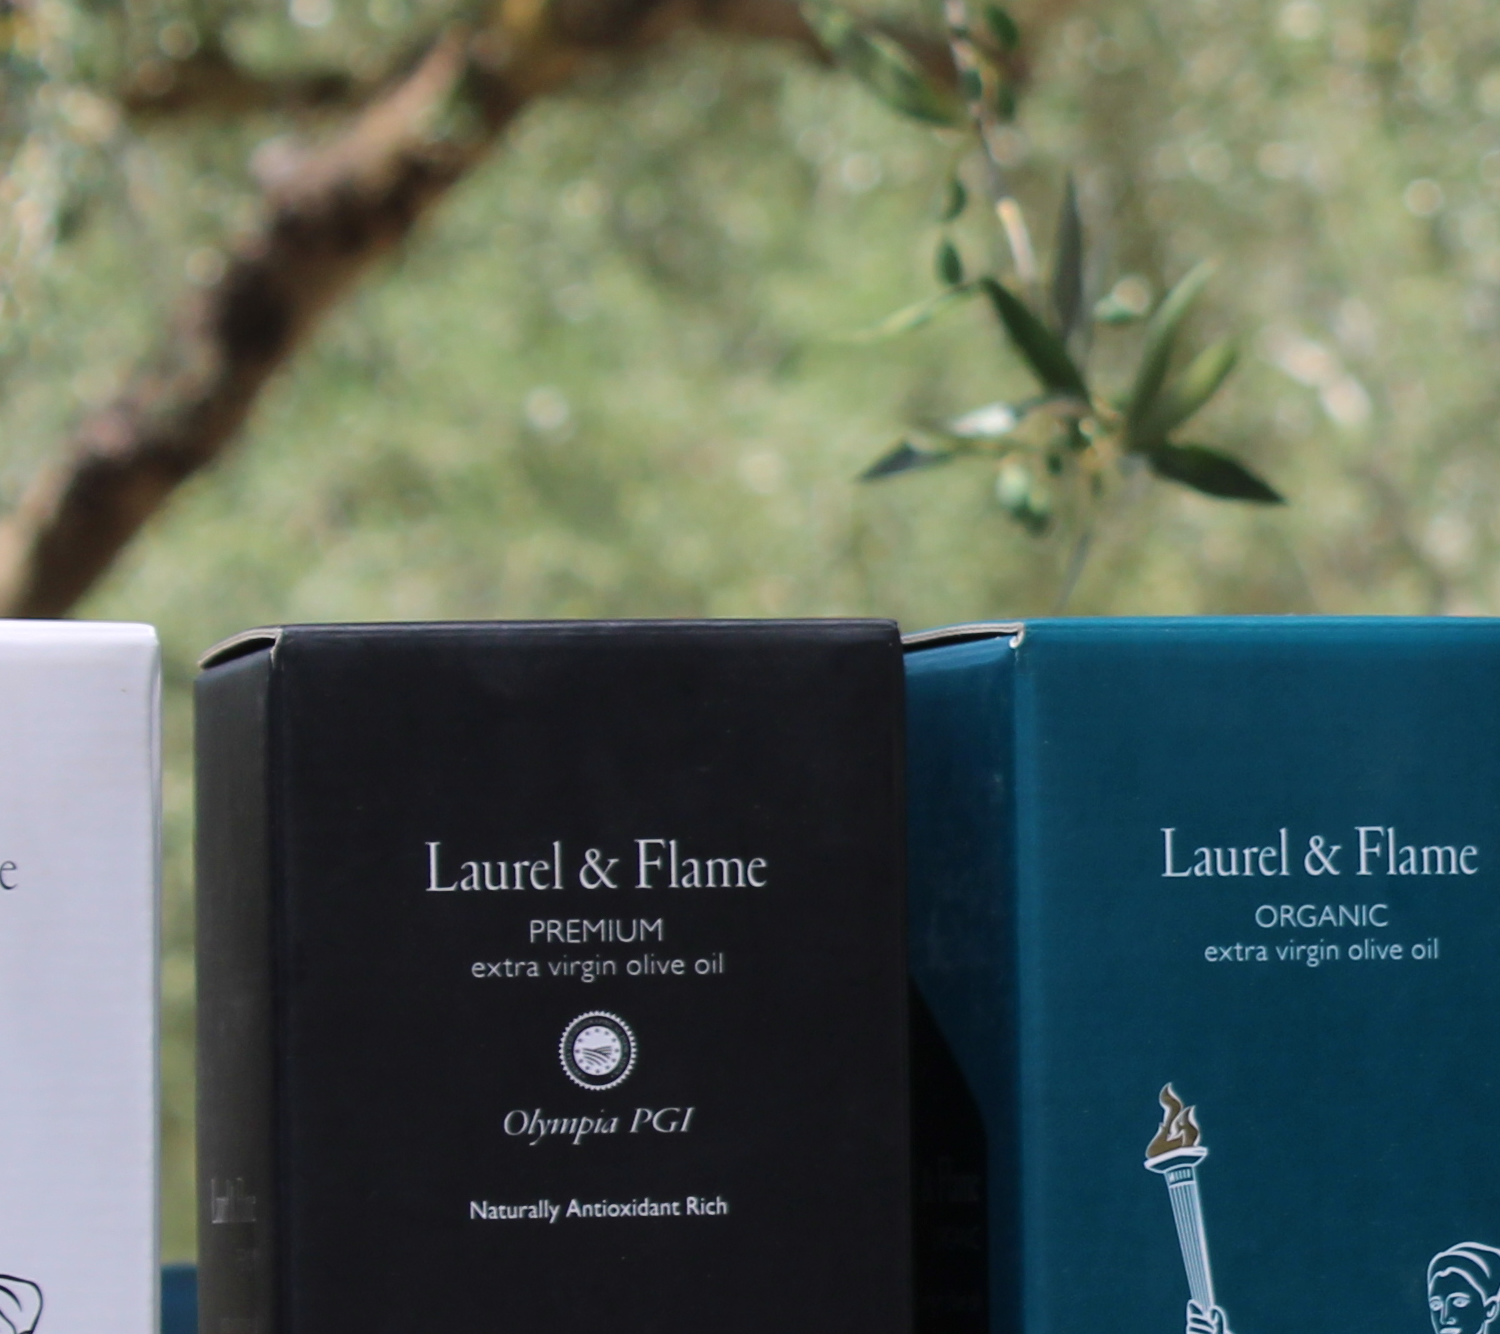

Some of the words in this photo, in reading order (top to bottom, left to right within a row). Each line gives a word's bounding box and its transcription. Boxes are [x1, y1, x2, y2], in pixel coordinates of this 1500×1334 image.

[425, 841, 564, 893] Laurel
[579, 848, 618, 891] &
[634, 838, 767, 891] Flame
[1160, 827, 1289, 879] Laurel
[1303, 835, 1341, 877] &
[1355, 826, 1479, 877] Flame
[529, 918, 664, 944] PREMIUM
[1254, 903, 1388, 929] ORGANIC
[471, 956, 540, 979] extra
[548, 953, 617, 983] virgin
[627, 953, 685, 978] olive
[695, 952, 725, 976] oil
[1204, 939, 1268, 963] extra
[1276, 939, 1341, 967] virgin
[1349, 938, 1403, 962] olive
[1411, 938, 1439, 961] oil
[503, 1107, 619, 1146] Olympia
[628, 1106, 694, 1135] PGI
[470, 1198, 560, 1224] Naturally
[566, 1197, 680, 1220] Antioxidant
[686, 1196, 728, 1217] Rich
